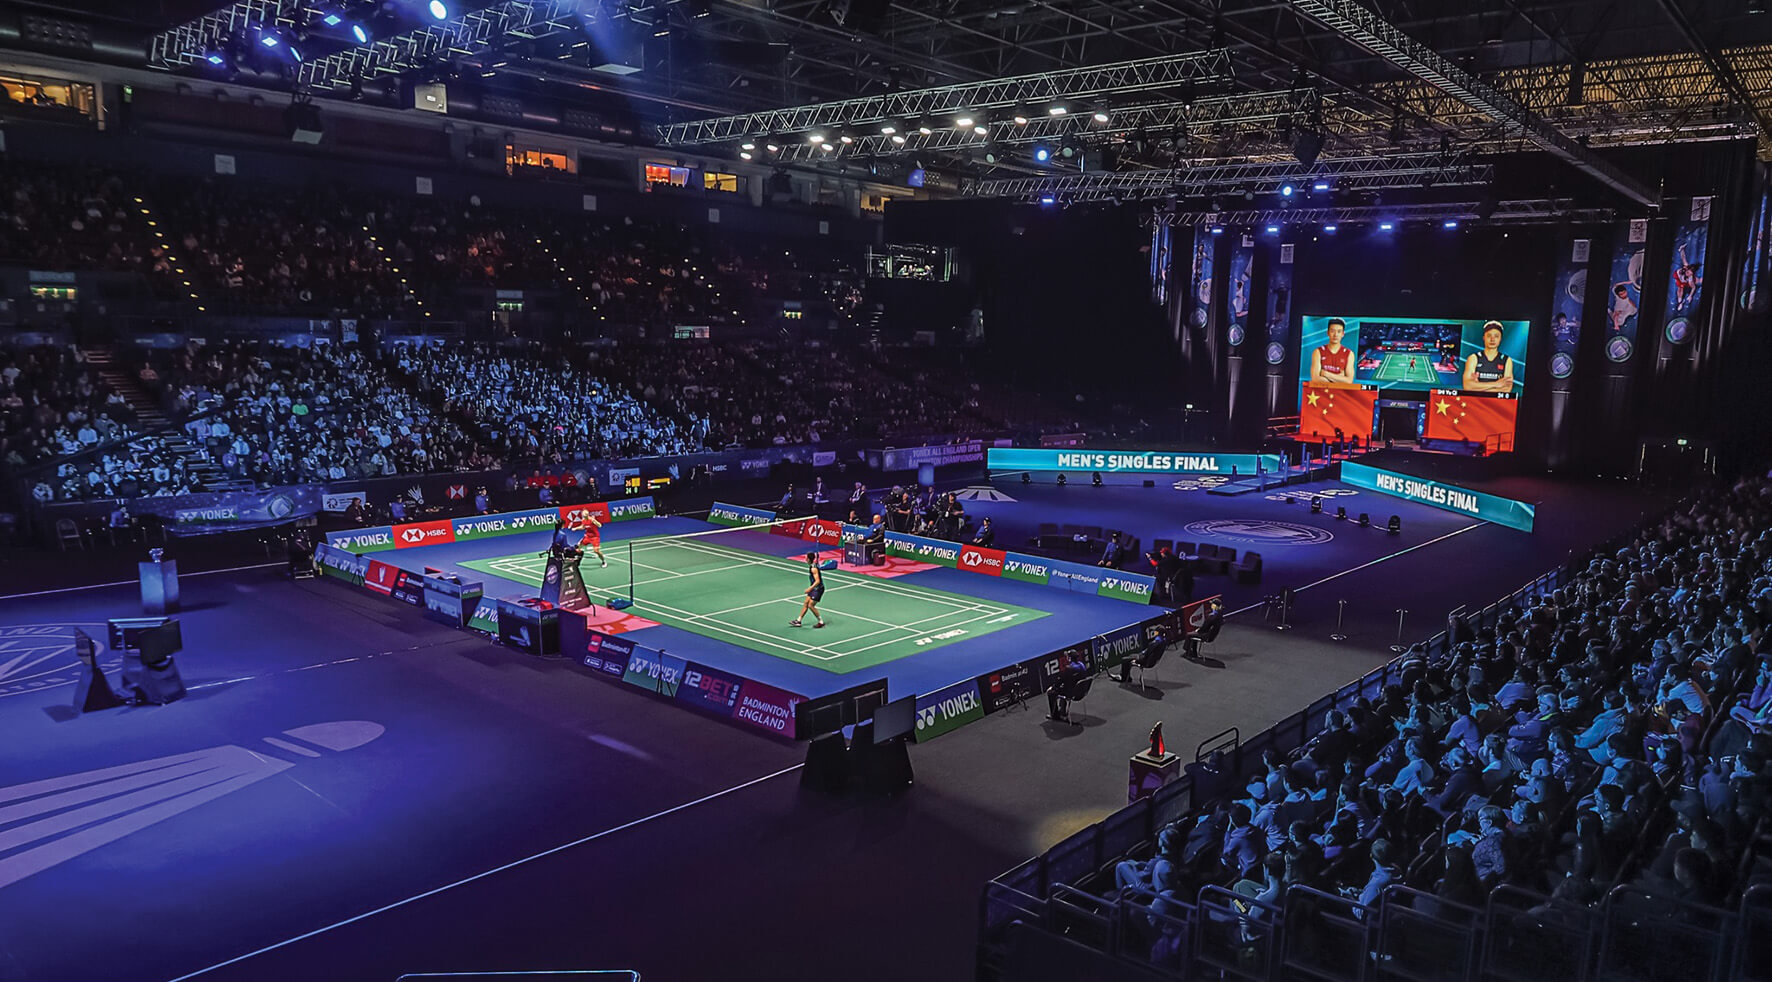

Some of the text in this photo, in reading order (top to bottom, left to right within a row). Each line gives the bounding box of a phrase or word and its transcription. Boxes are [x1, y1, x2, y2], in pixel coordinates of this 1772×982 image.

[932, 447, 942, 456] ALL
[943, 445, 967, 455] ENGLAND
[968, 444, 981, 452] OPEN
[712, 464, 727, 472] HSBC
[1058, 453, 1219, 471] MEN'S SINGLES FINAL
[1376, 473, 1479, 513] MEN'S SINGLES FINAL
[200, 508, 235, 521] YONEX
[626, 502, 653, 515] YONEX
[721, 510, 740, 521] YONEX
[475, 513, 558, 533] YONEX YONEX
[353, 533, 389, 547] YONEX
[426, 528, 447, 537] HSBC
[824, 529, 839, 538] HSBC
[893, 539, 957, 560] YONEX YONEX
[983, 557, 1001, 567] HSBC
[1020, 563, 1048, 577] YONEX
[1119, 580, 1149, 596] YONEX
[1112, 633, 1140, 657] YONEX
[684, 670, 734, 698] 12BET
[742, 696, 790, 719] BADMINTON
[938, 689, 980, 721] YONEX
[738, 706, 786, 731] ENGLAND
